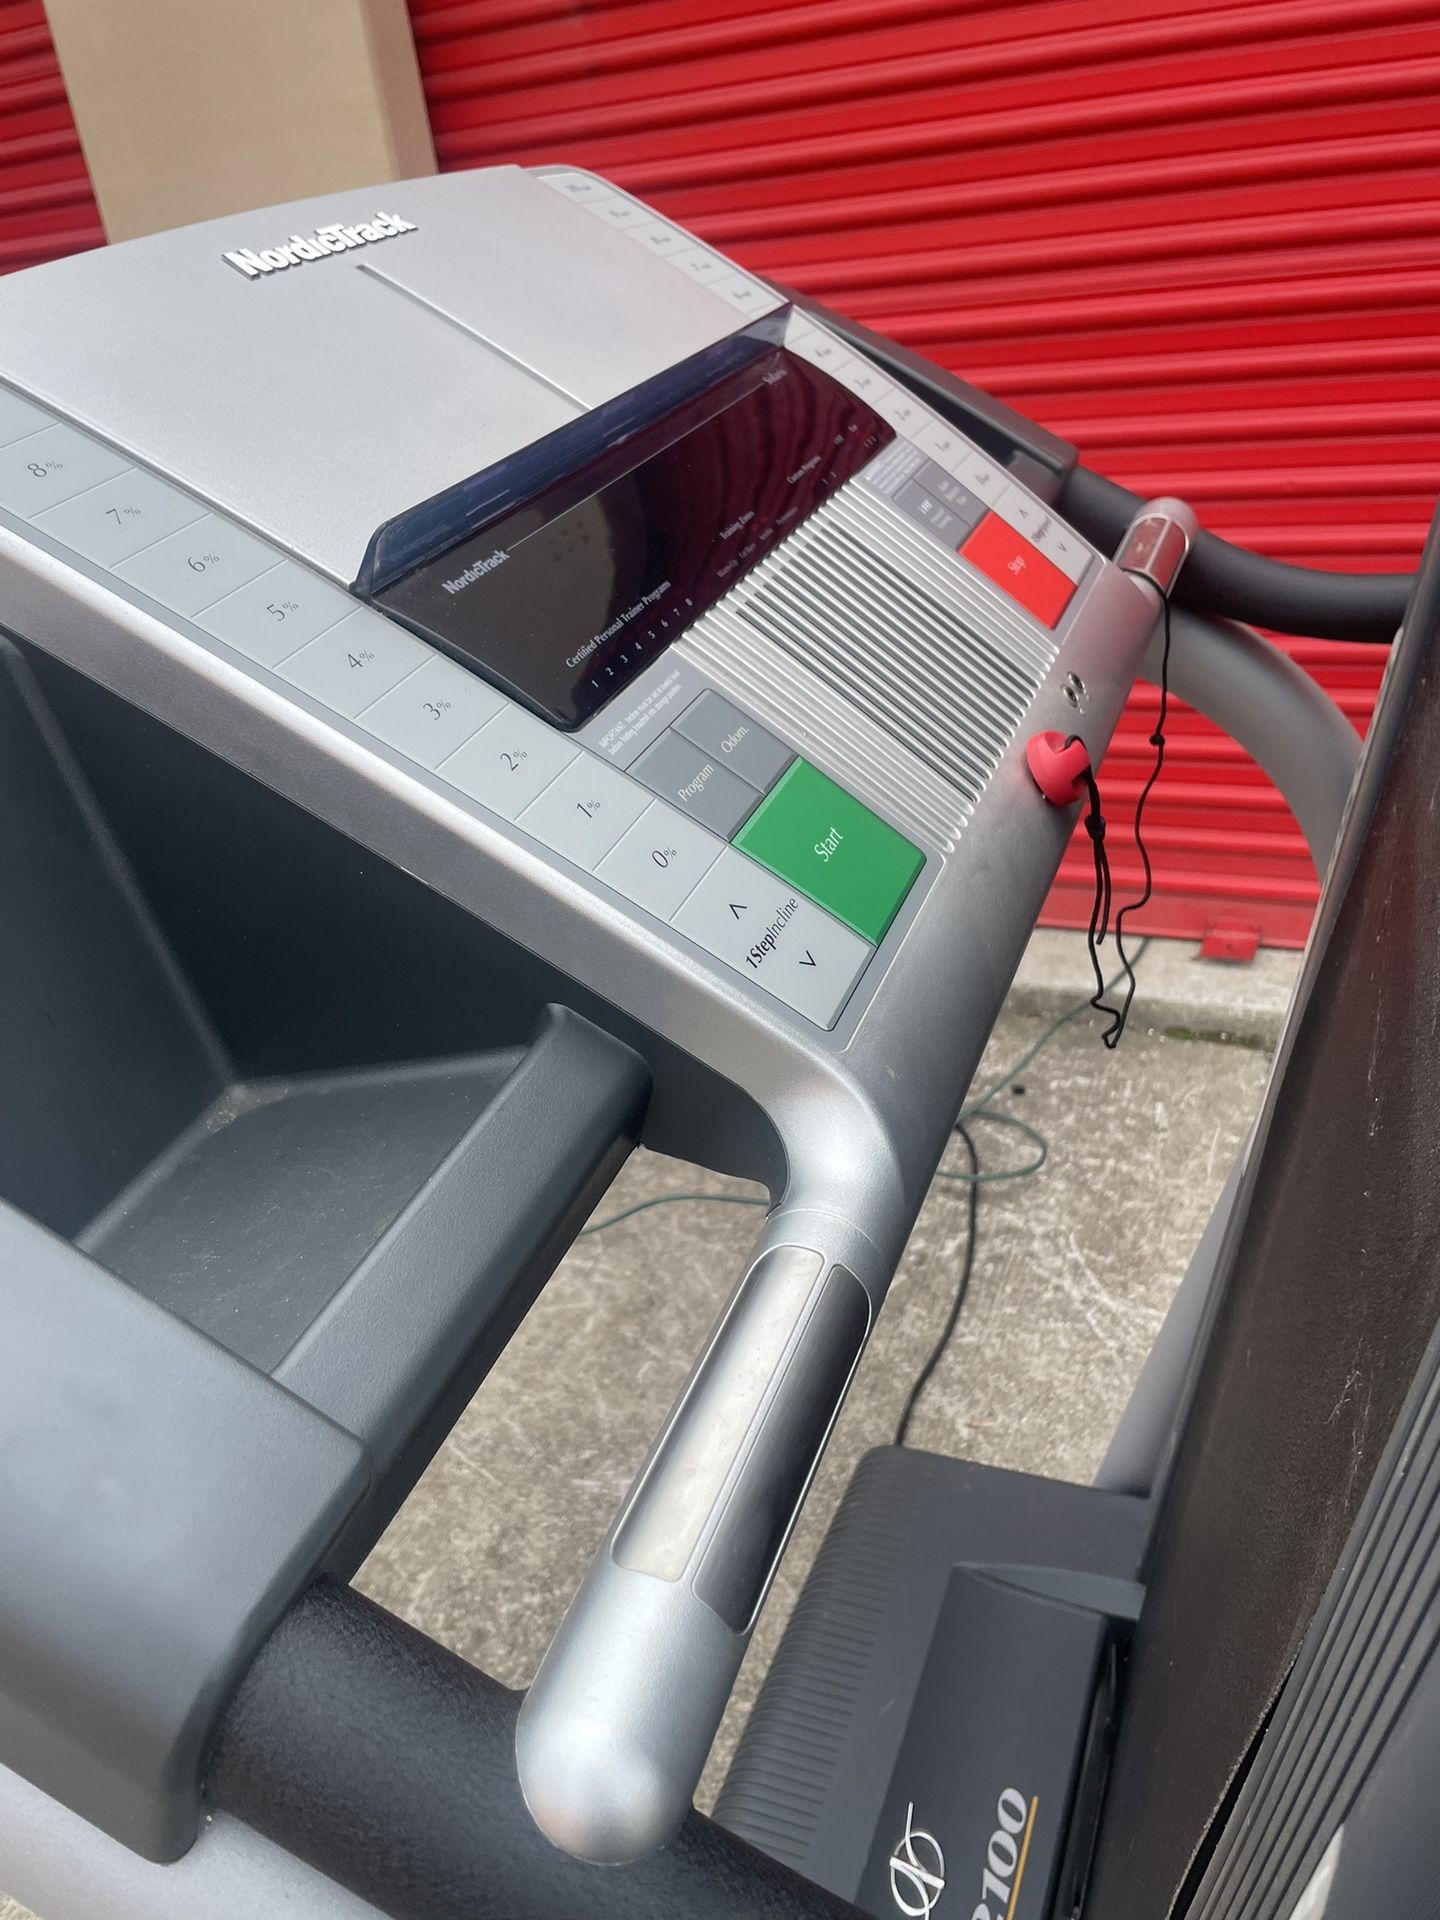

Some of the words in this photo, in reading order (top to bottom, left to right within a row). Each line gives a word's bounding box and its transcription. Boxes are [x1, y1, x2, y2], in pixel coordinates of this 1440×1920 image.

[223, 211, 418, 280] NordicTrack
[27, 459, 63, 478] 8%
[105, 505, 141, 525] 7%
[187, 553, 220, 573] 6%
[441, 549, 511, 595] NordicTrack
[267, 600, 299, 622] 5%
[565, 638, 598, 668] Certified
[594, 617, 624, 646] Personal
[620, 601, 645, 624] Trainer
[642, 580, 672, 607] Programs
[591, 679, 600, 689] 1
[605, 667, 614, 677] 2
[620, 654, 629, 664] 3
[634, 642, 643, 652] 4
[647, 630, 656, 640] 5
[661, 619, 669, 629] 6
[673, 608, 681, 617] 7
[347, 650, 375, 670] 4%
[423, 699, 451, 720] 3%
[720, 726, 750, 753] Odom.
[500, 749, 527, 771] 2%
[677, 764, 715, 802] Program
[576, 800, 601, 818] 1%
[814, 827, 843, 862] Start
[651, 847, 677, 868] 0%
